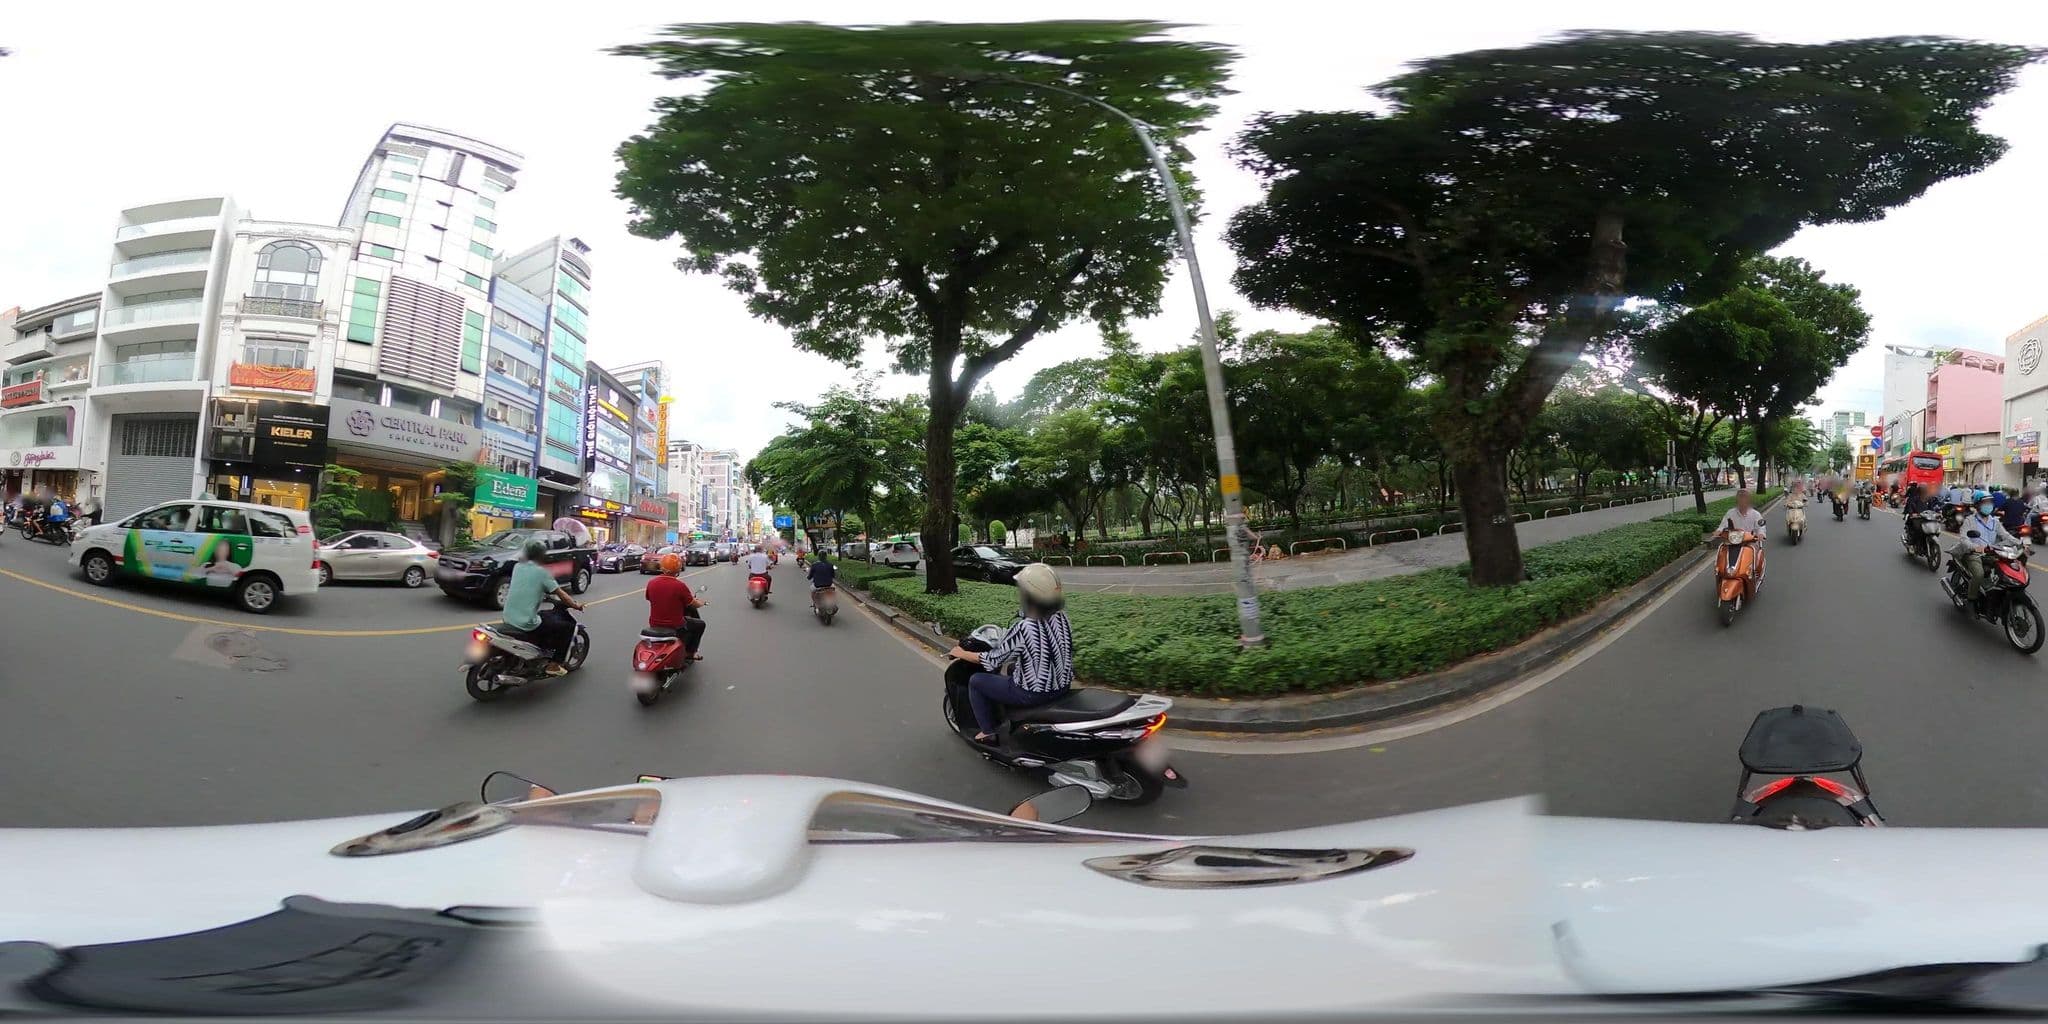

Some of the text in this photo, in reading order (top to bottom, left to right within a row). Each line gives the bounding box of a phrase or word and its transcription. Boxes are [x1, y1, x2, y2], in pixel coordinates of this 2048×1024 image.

[270, 425, 313, 440] KIELER
[380, 416, 468, 445] CENTRAL PARK
[492, 480, 527, 498] Edena
